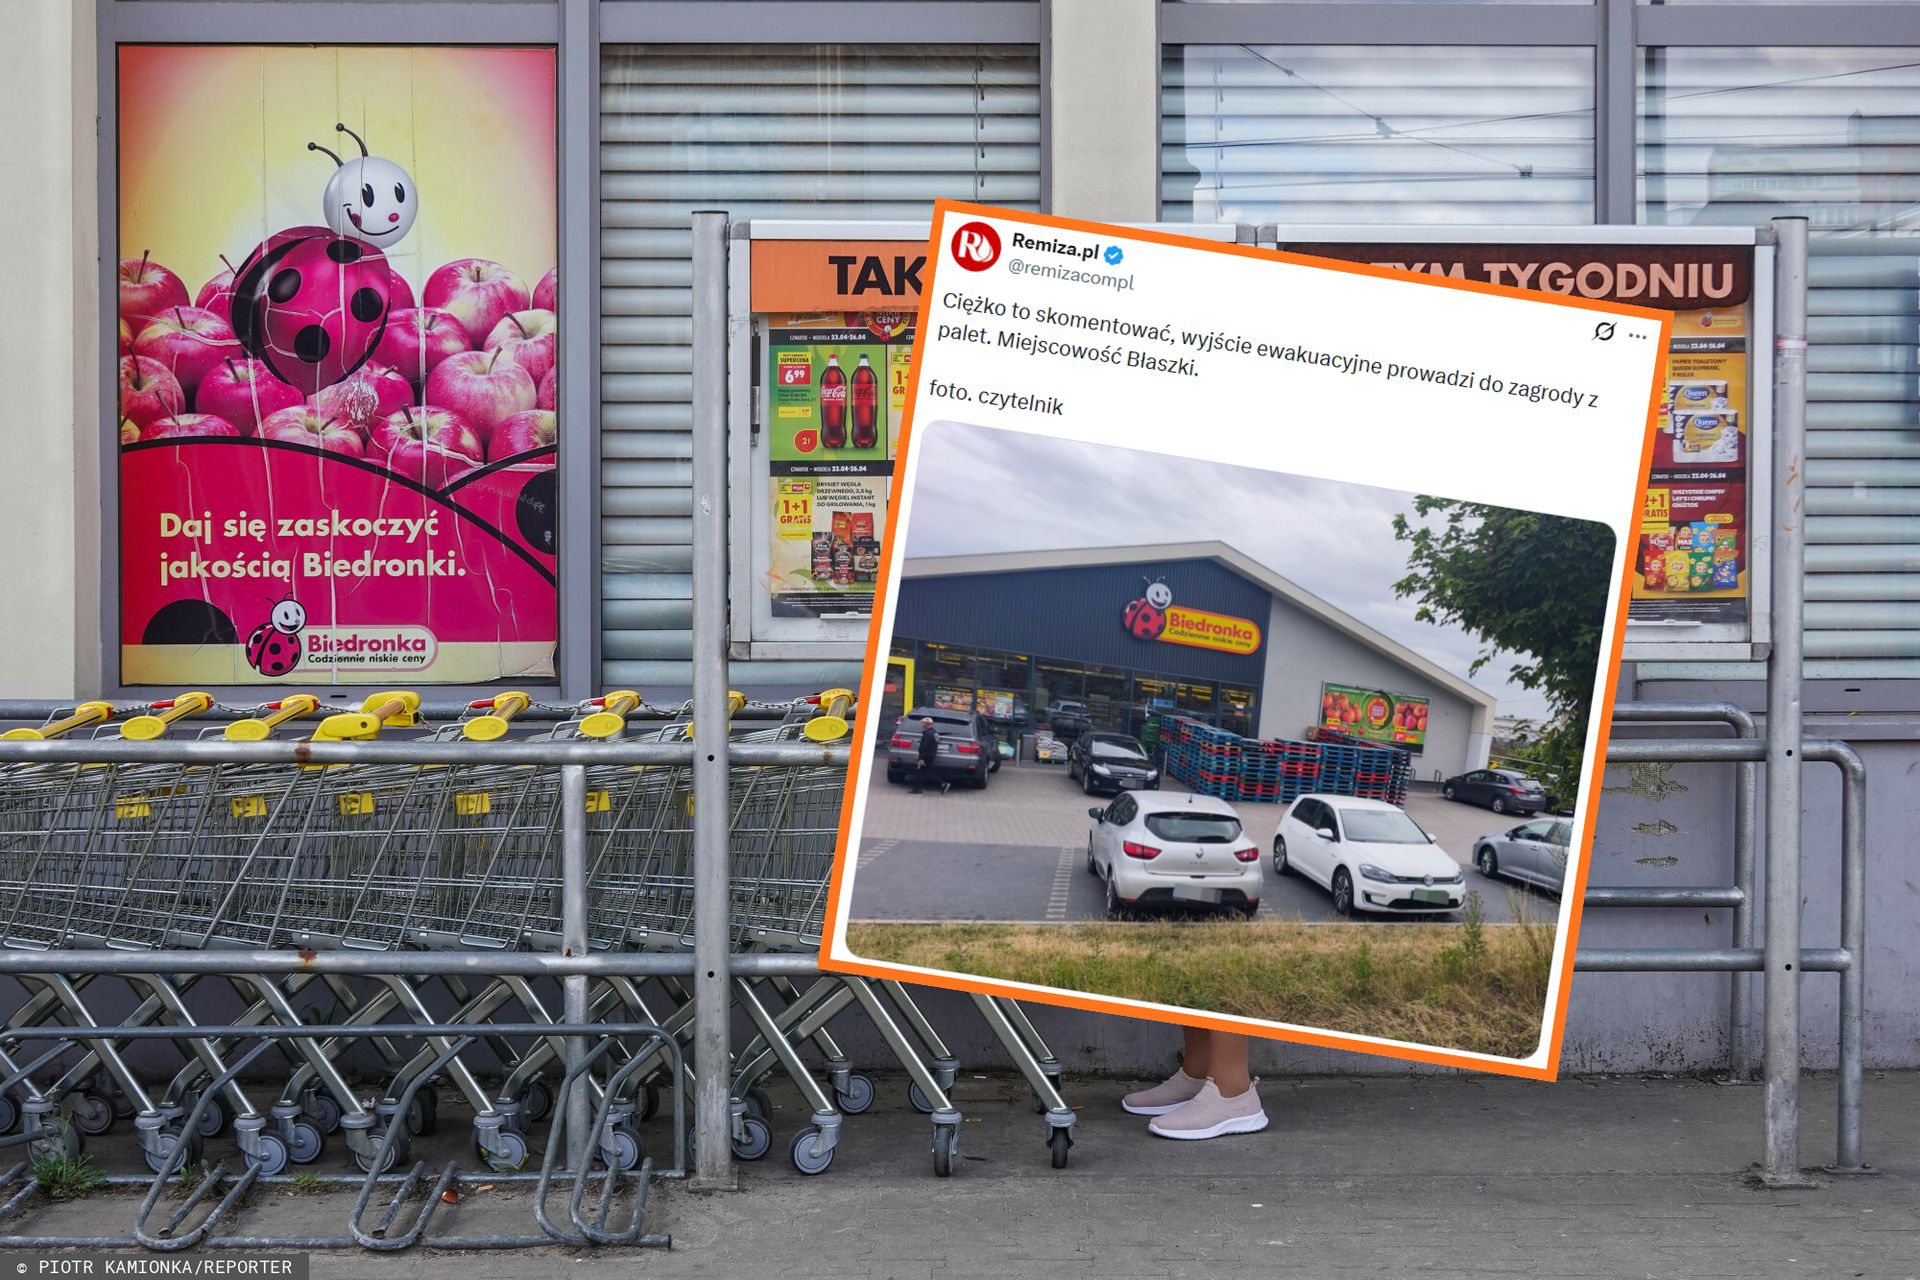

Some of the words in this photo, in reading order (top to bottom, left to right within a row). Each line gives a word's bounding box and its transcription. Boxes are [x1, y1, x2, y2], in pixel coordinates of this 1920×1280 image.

[1482, 262, 1733, 299] TYGODNIU
[876, 316, 900, 324] CENY
[1683, 389, 1708, 397] Queen
[1693, 418, 1718, 426] Queen
[783, 499, 808, 514] 1+1
[1644, 509, 1668, 517] RATIS
[780, 515, 812, 525] GRATIS
[160, 510, 212, 545] Daj
[223, 510, 266, 542] się
[277, 509, 439, 543] zaskoczyć
[160, 551, 290, 586] jakością
[303, 549, 466, 577] Biedronki.
[1169, 613, 1253, 640] Biedronka
[1168, 627, 1210, 640] Codziennie
[308, 634, 426, 652] Biedronka
[308, 653, 365, 663] Codziennie
[369, 653, 398, 663] niskie
[402, 655, 426, 664] ceny
